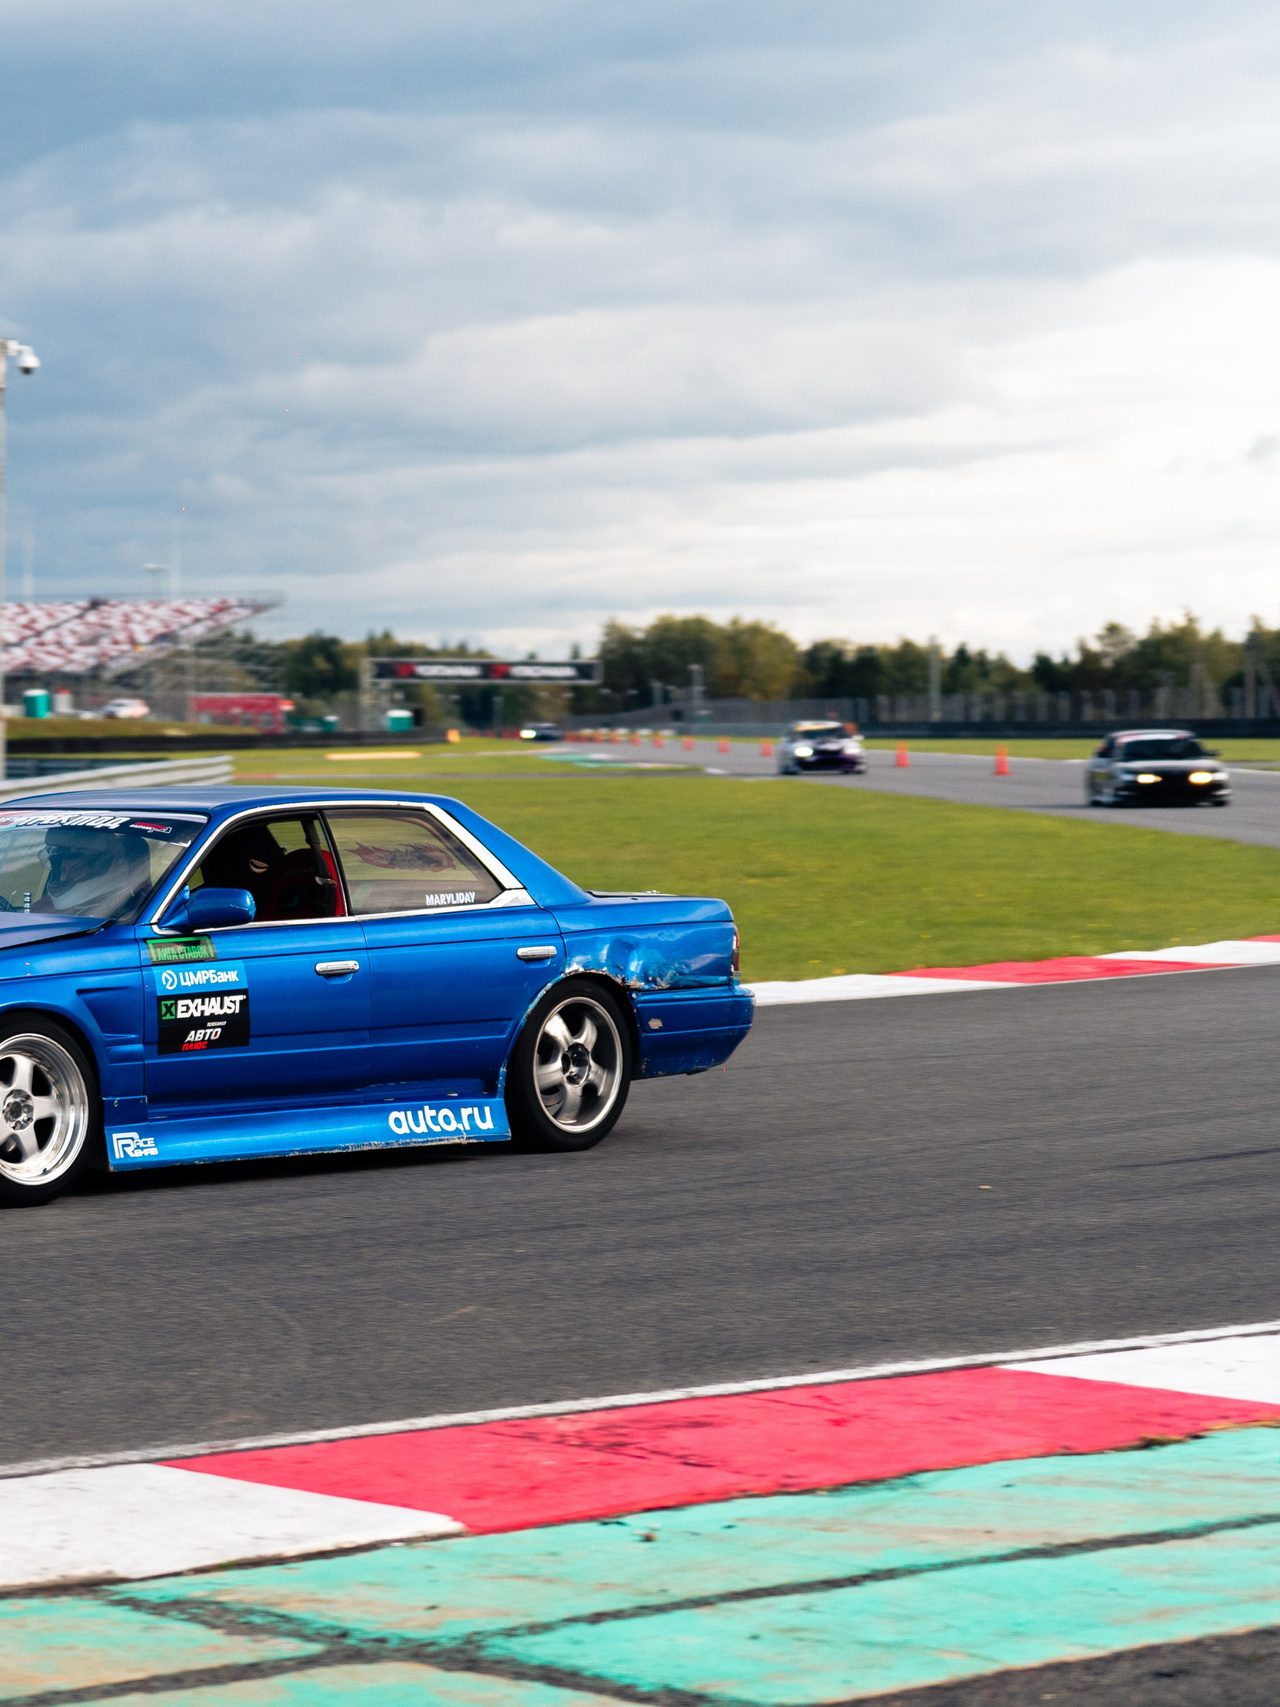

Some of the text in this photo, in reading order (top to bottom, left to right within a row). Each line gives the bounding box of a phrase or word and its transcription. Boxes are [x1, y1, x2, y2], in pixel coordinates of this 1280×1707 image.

[425, 892, 476, 906] MARYLIDAY
[156, 945, 209, 961] ЛИГА СТАВОК
[179, 970, 240, 987] ЦМРБанк
[176, 995, 246, 1019] EXHAUST
[184, 1028, 222, 1043] АВТО
[181, 1041, 209, 1052] ПЛЮС
[388, 1105, 494, 1135] auto.ru
